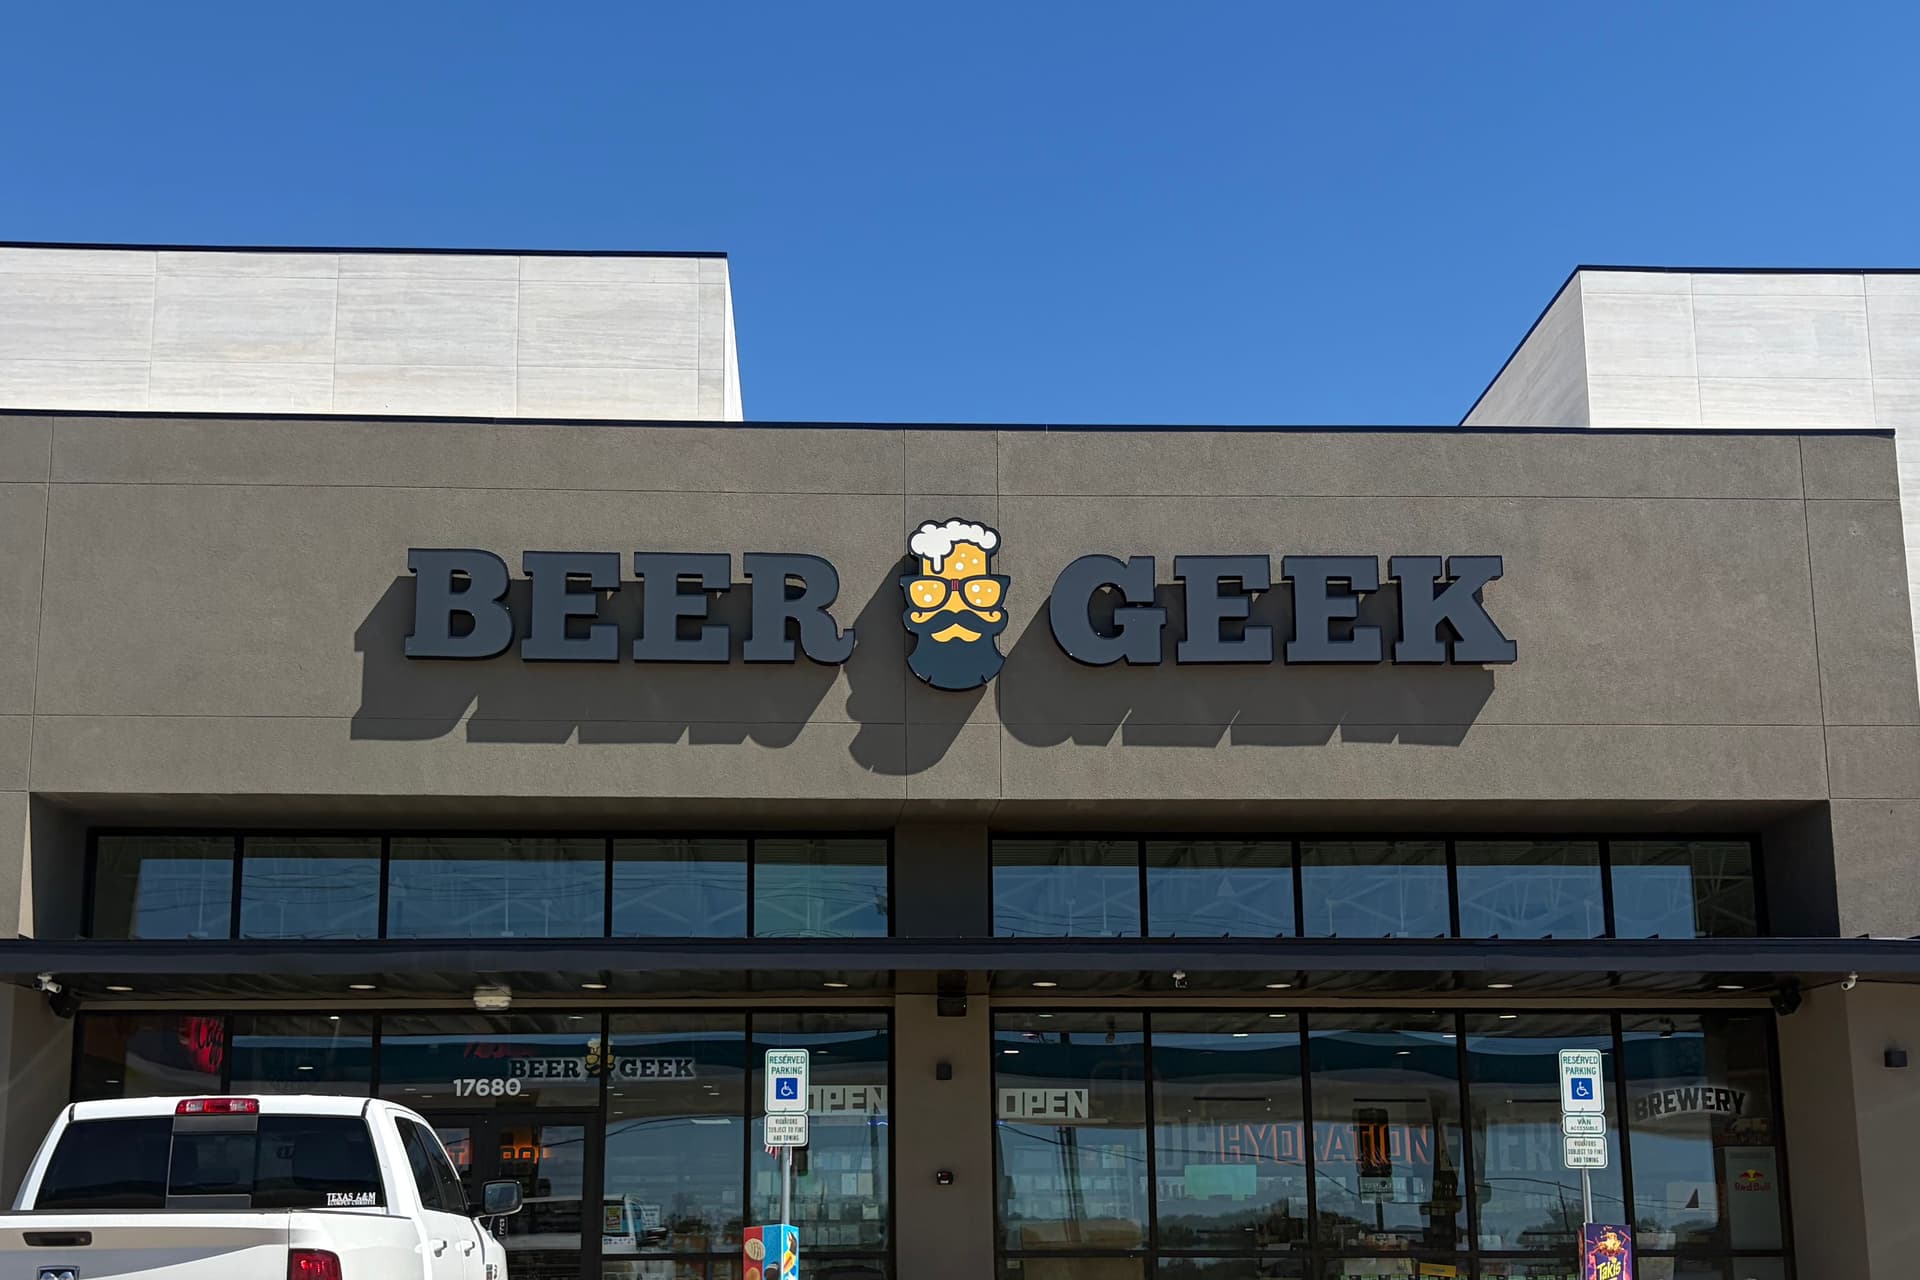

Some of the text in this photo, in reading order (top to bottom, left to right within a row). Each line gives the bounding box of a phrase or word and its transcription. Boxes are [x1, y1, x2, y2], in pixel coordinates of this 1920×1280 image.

[405, 547, 1518, 666] BEER GEEK
[509, 1058, 697, 1079] BEER GEEK
[769, 1055, 806, 1065] RESERVED
[1562, 1055, 1598, 1065] RESERVED
[771, 1066, 803, 1075] PARKING
[1565, 1066, 1597, 1076] PARKING
[453, 1078, 522, 1097] 17680
[999, 1089, 1088, 1118] OPEN
[1634, 1087, 1746, 1122] BREWERY
[326, 1192, 354, 1202] TEXAS
[1597, 1261, 1622, 1280] Takis
